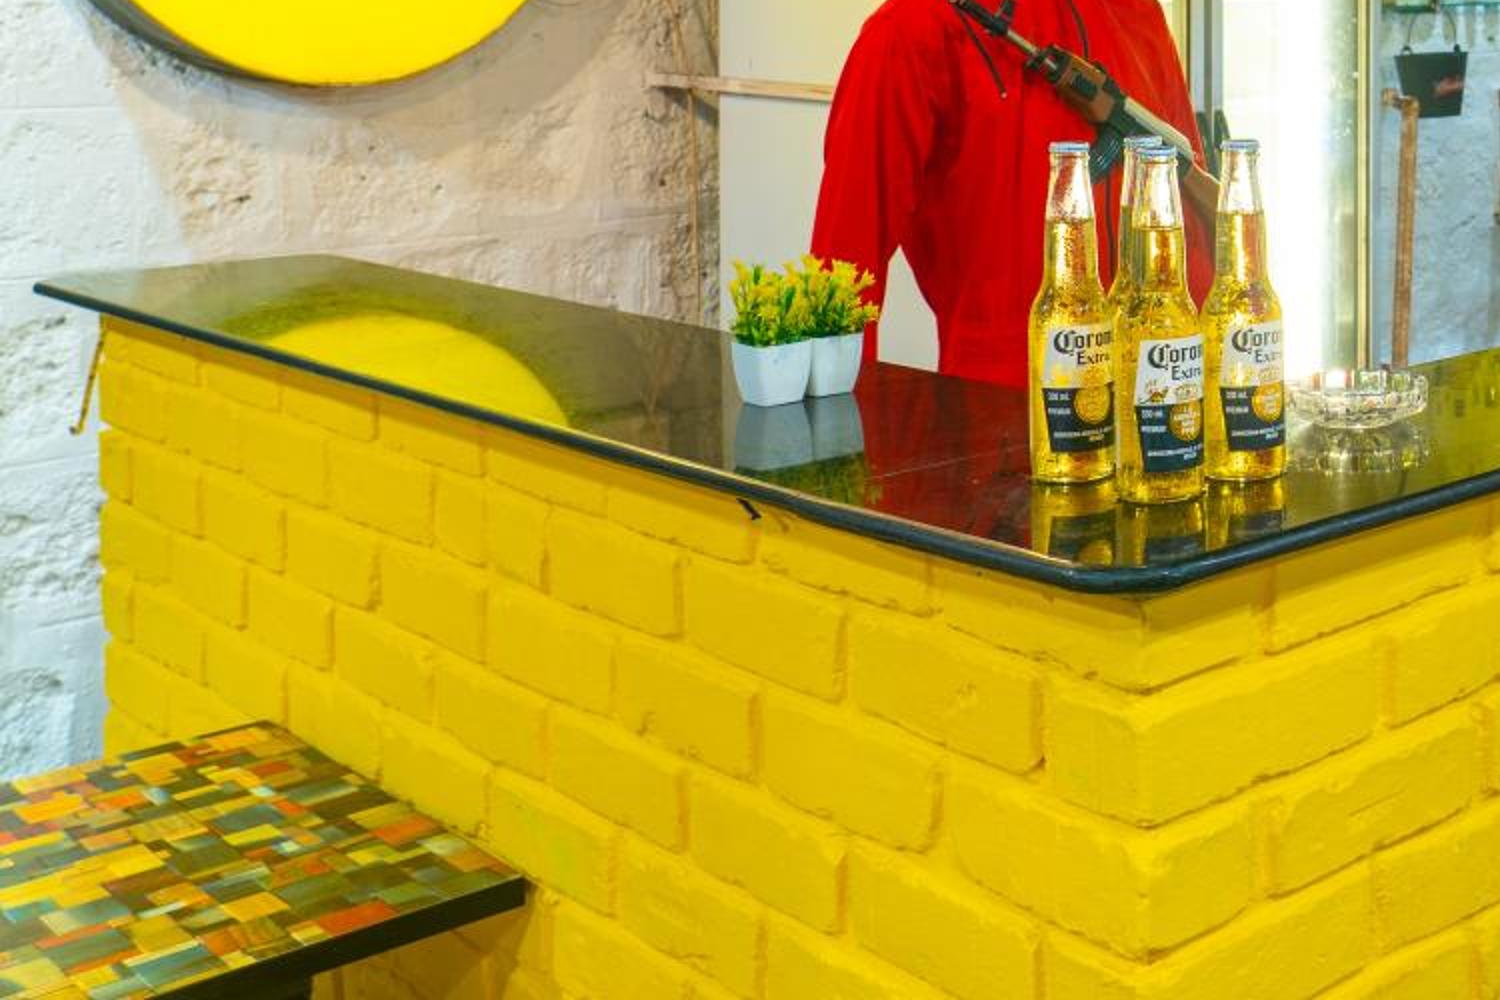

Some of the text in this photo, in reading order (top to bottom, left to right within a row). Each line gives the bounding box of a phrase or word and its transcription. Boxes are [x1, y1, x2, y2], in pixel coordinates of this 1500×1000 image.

[1053, 329, 1112, 356] Coron
[1231, 327, 1281, 355] Coro
[1147, 342, 1203, 371] Coro
[1171, 364, 1203, 382] Extr
